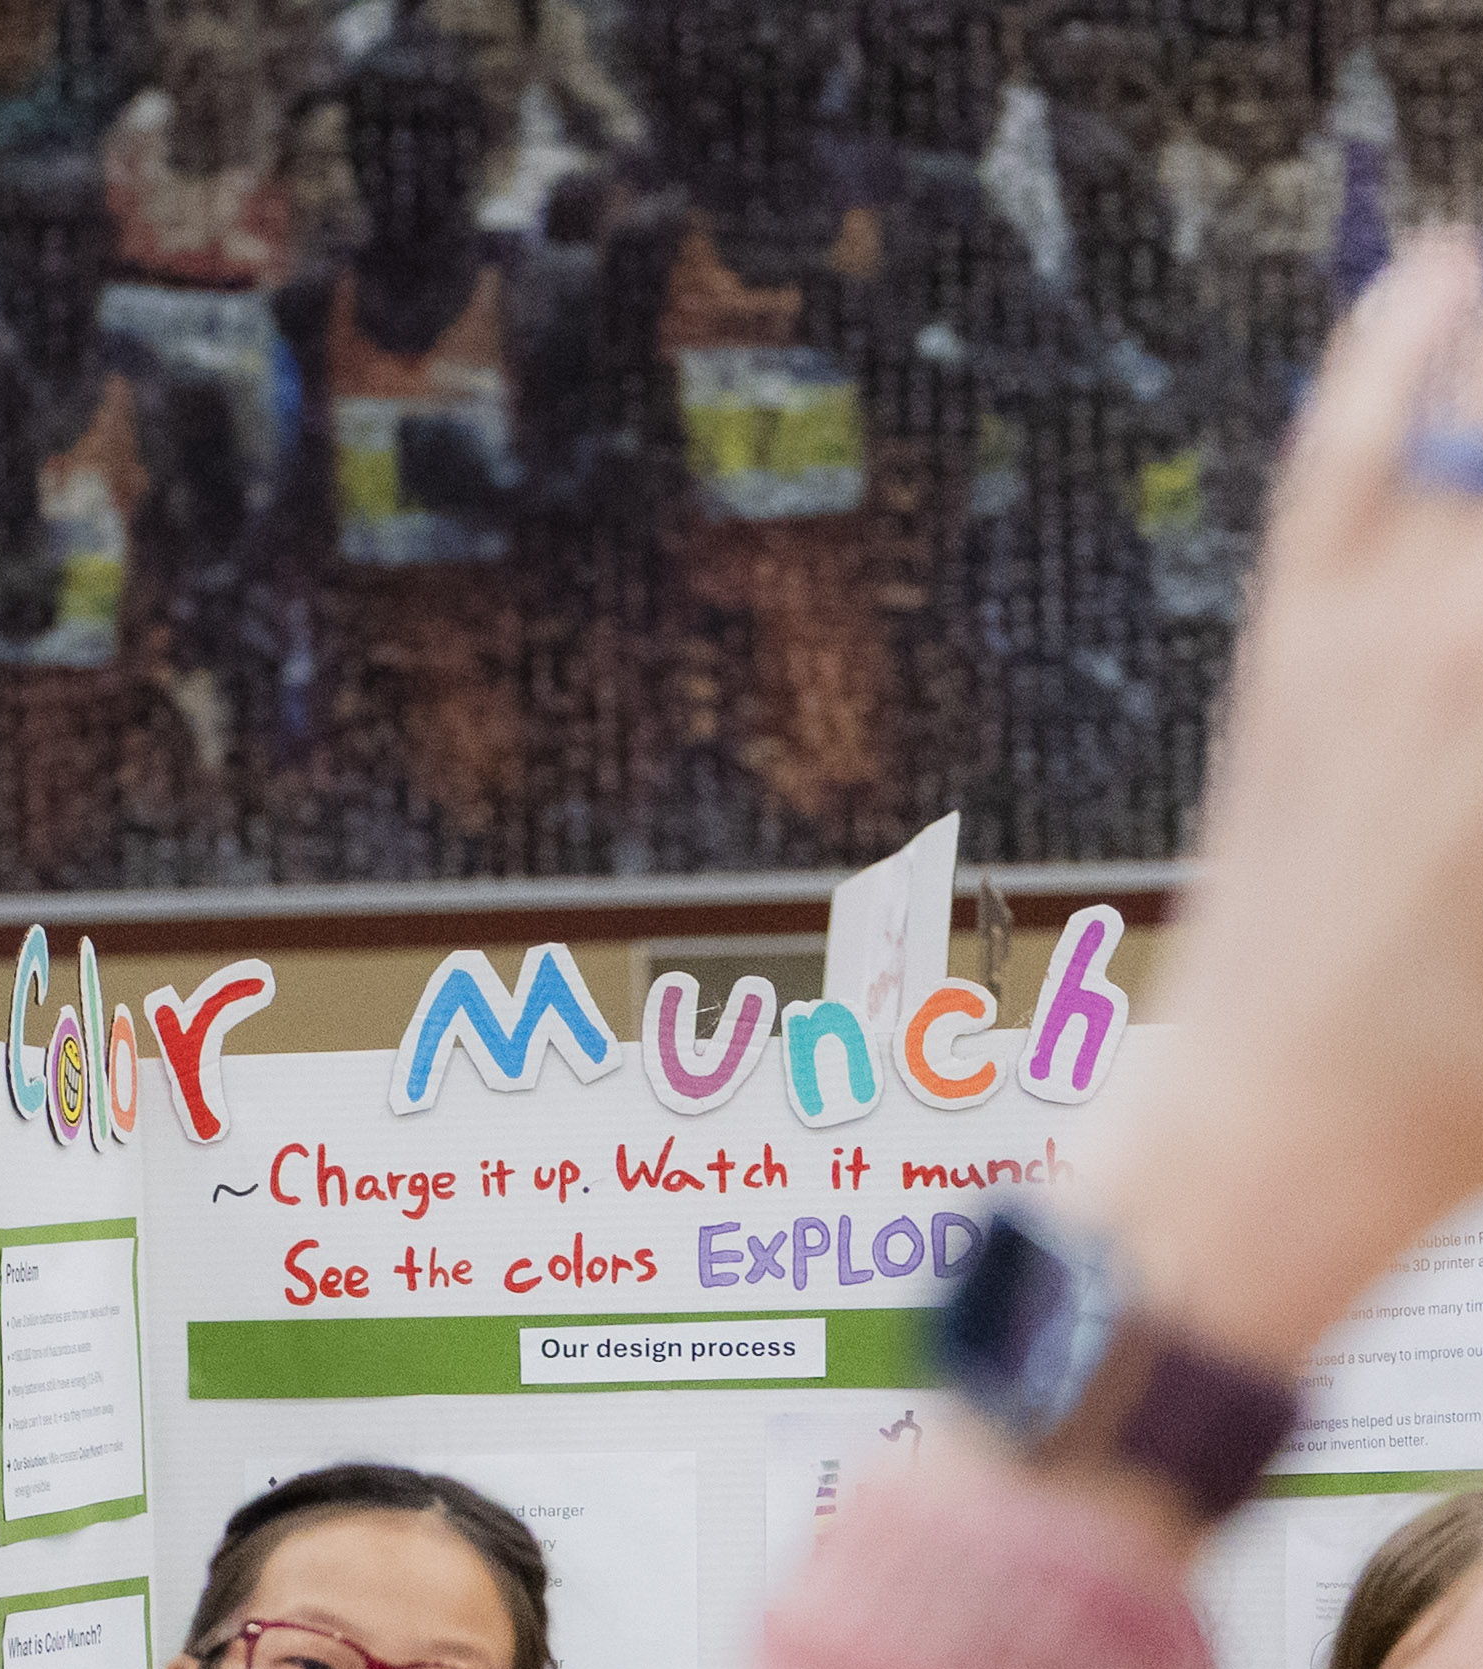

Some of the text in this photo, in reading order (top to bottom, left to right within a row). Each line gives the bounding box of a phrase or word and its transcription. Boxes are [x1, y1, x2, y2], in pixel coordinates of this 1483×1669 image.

[10, 916, 1119, 1145] Color Munch
[480, 1159, 516, 1197] it
[616, 1135, 788, 1193] Watch
[832, 1146, 871, 1190] it
[1464, 1232, 1475, 1246] in
[284, 1212, 985, 1306] See the colors EXPLOD
[1413, 1258, 1430, 1272] 3D
[1434, 1256, 1474, 1274] printer
[540, 1338, 796, 1363] Our design process
[1308, 1434, 1430, 1452] our invention better.
[529, 1503, 585, 1521] charger
[7, 1636, 33, 1659] What
